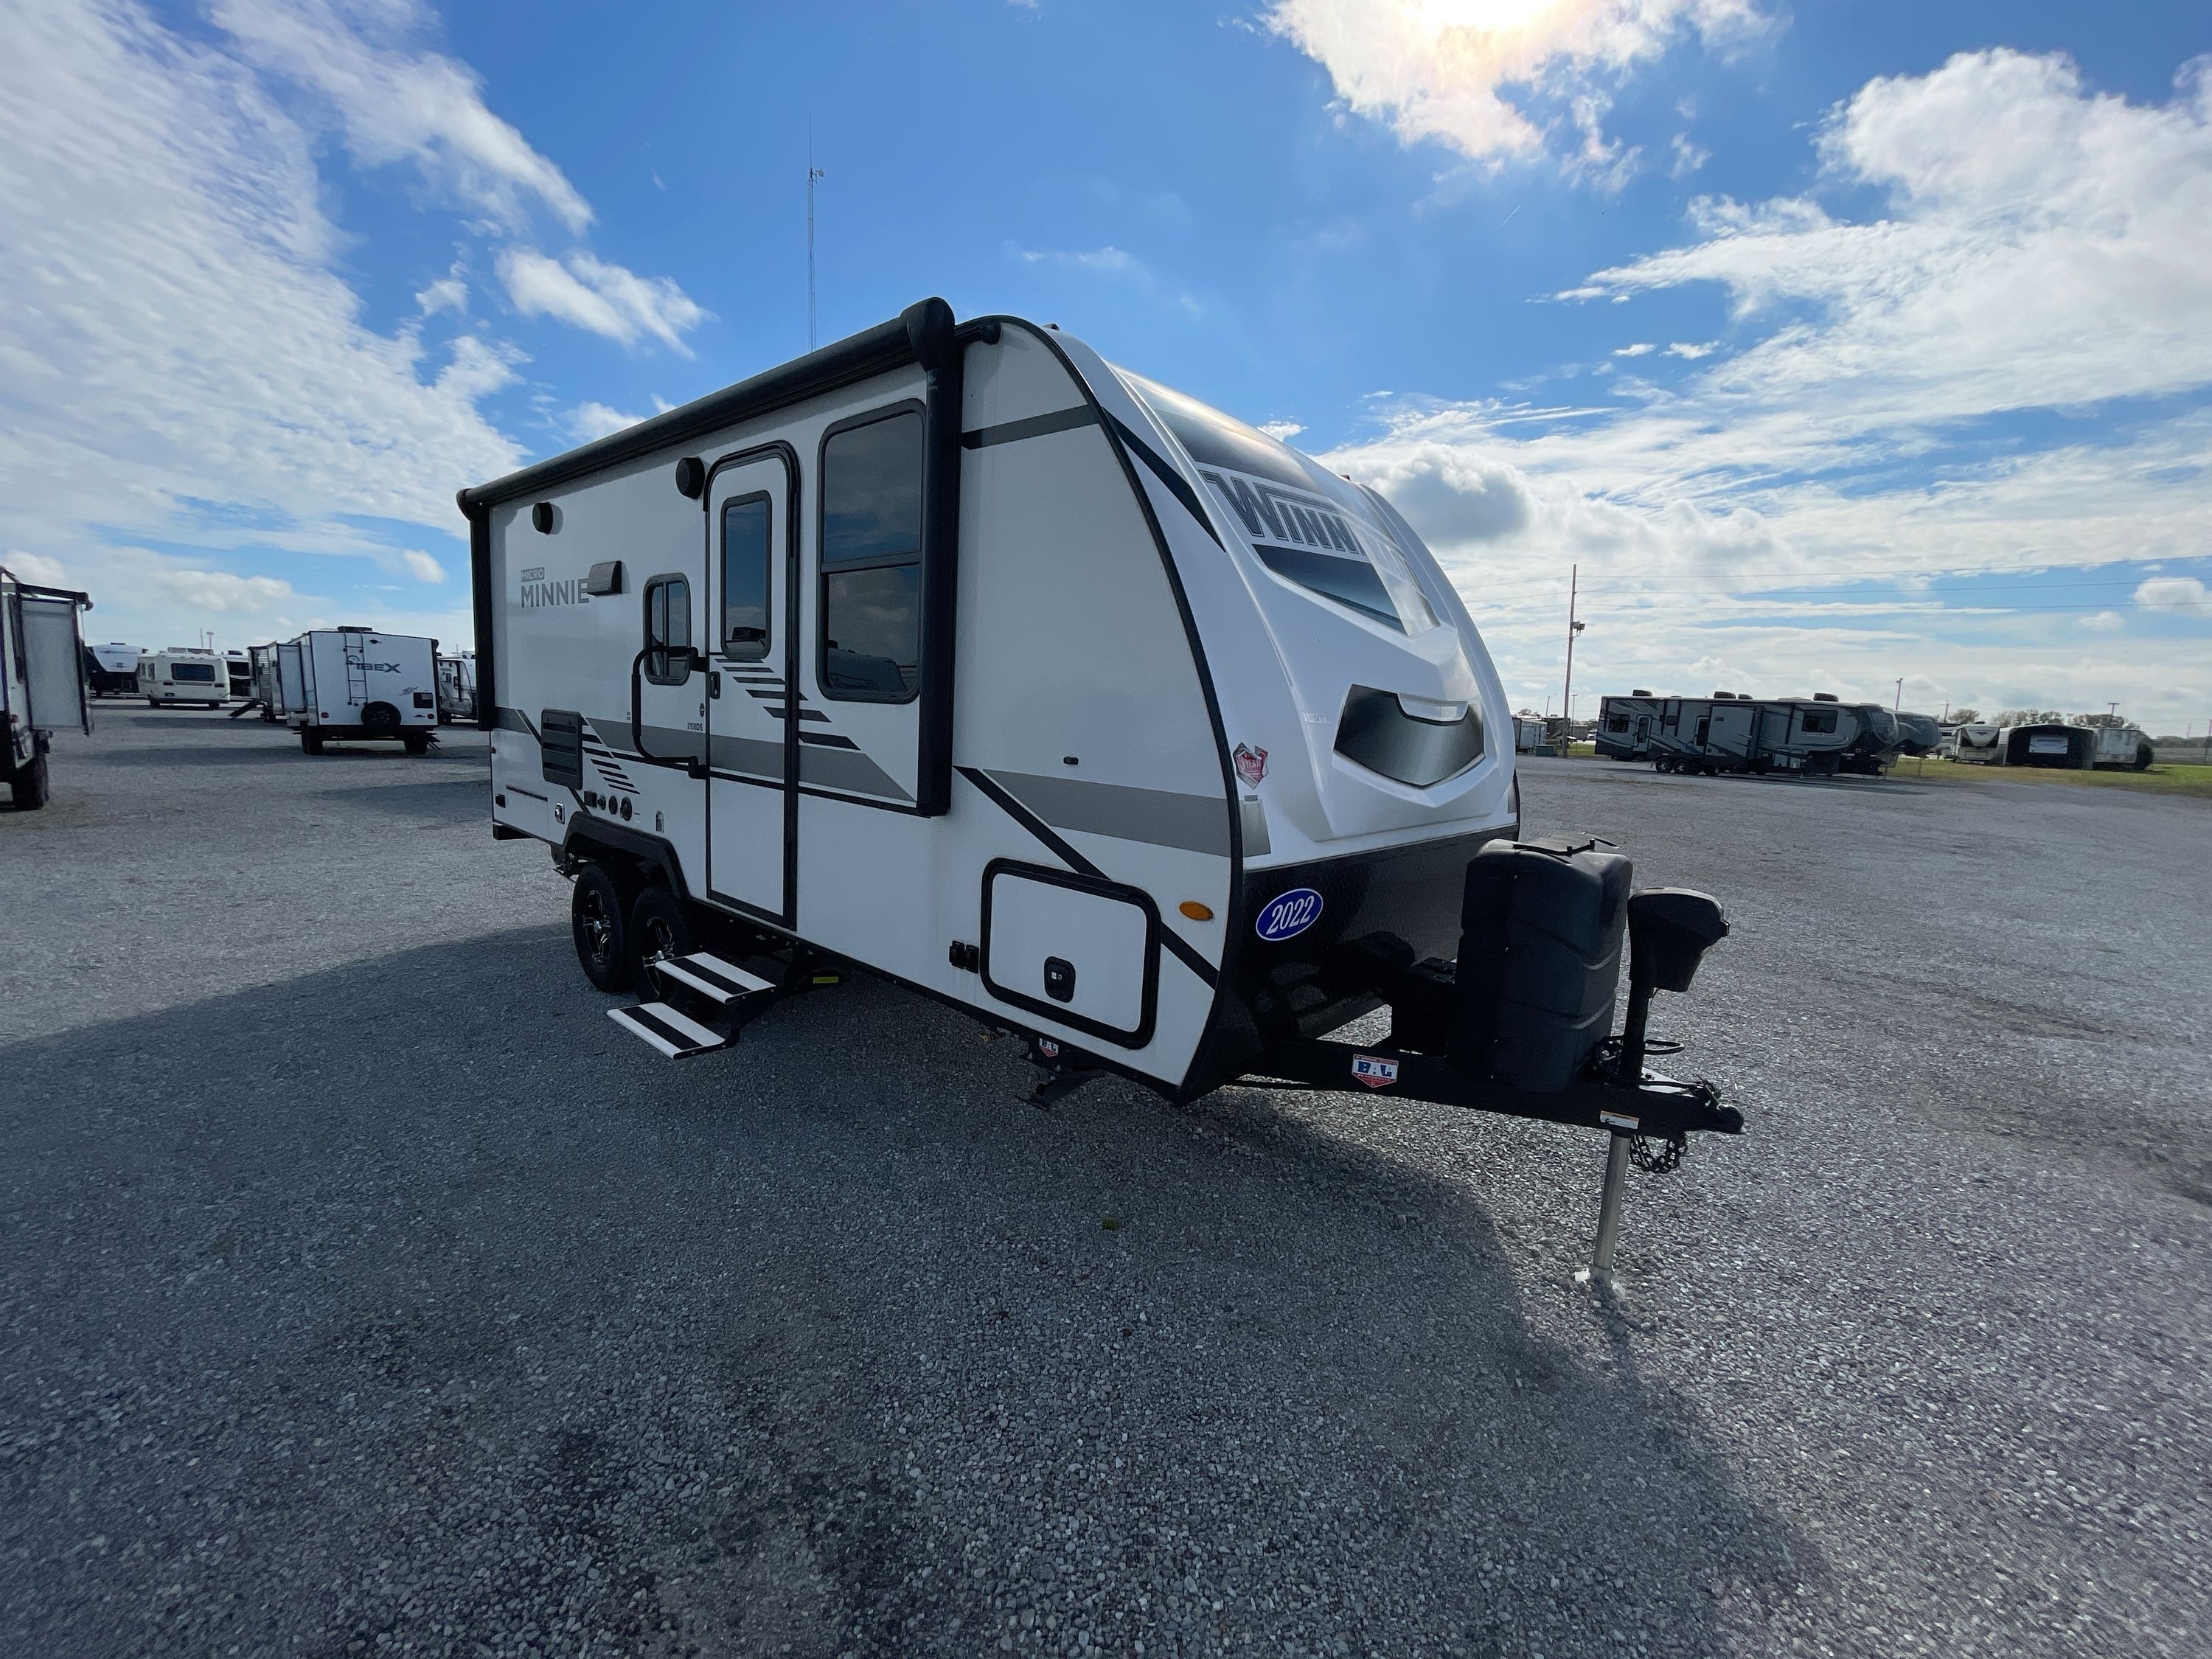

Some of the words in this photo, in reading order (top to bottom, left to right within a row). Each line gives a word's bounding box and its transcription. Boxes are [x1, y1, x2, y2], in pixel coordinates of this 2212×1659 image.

[521, 568, 544, 581] MICRO
[521, 580, 590, 608] MINNIE
[1266, 895, 1315, 935] 2022
